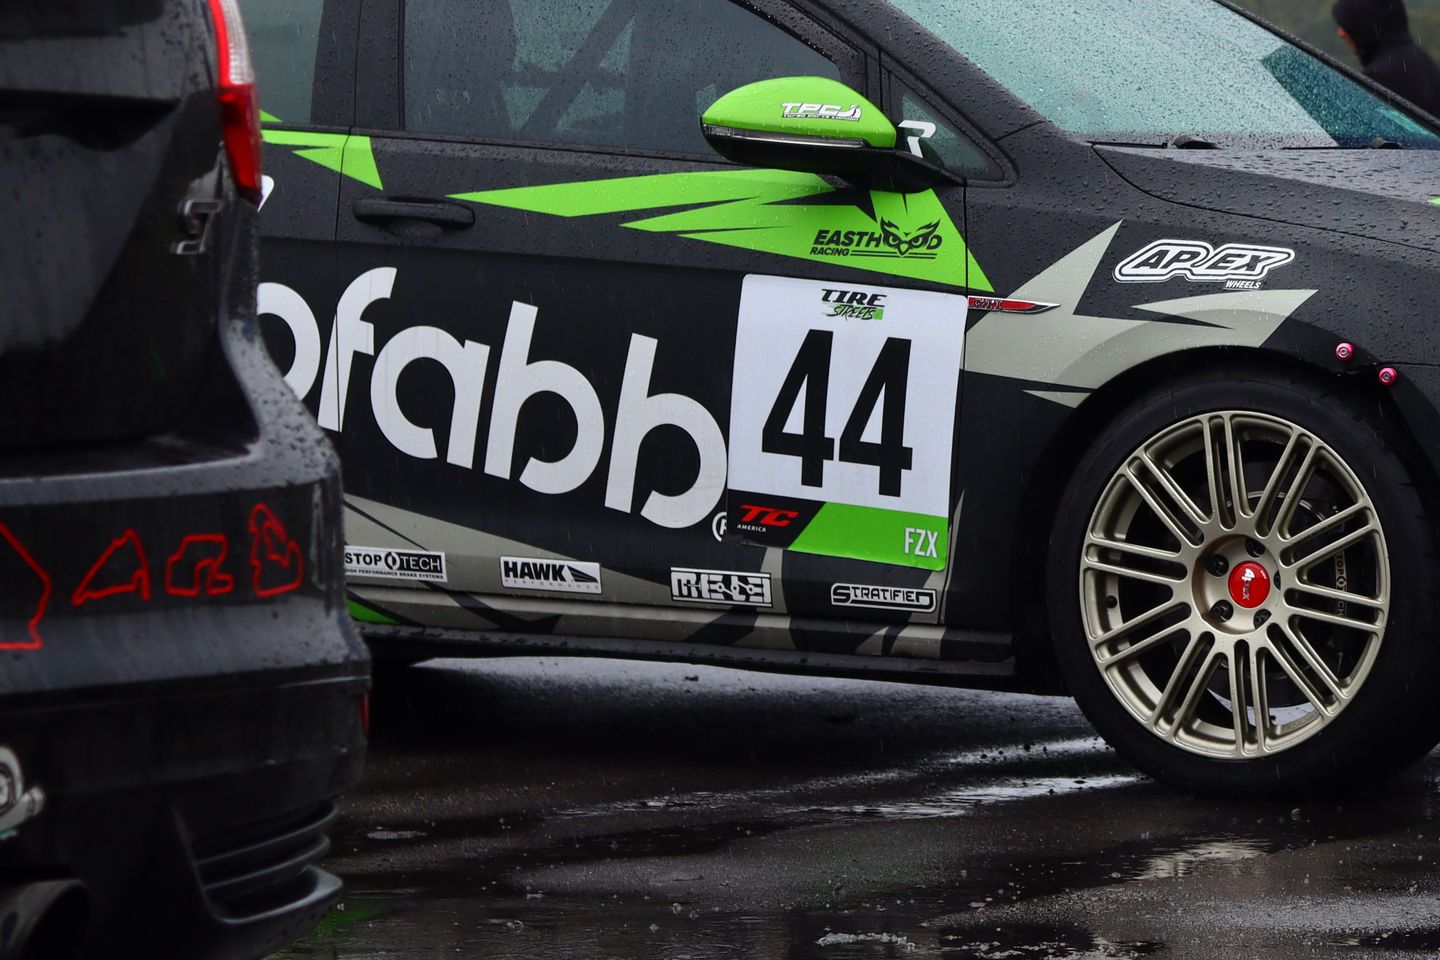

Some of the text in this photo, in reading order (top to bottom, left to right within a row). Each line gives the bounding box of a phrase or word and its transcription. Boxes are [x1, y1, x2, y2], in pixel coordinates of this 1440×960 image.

[810, 246, 850, 257] RACING
[1120, 242, 1290, 277] APEX
[1225, 279, 1262, 290] WHEELS
[821, 288, 887, 308] TIRE
[761, 329, 913, 498] 44
[738, 504, 801, 528] TC
[736, 523, 767, 534] AMERICA
[904, 526, 939, 559] FZX
[503, 560, 567, 583] HAWK
[832, 582, 936, 613] STRATIFIED
